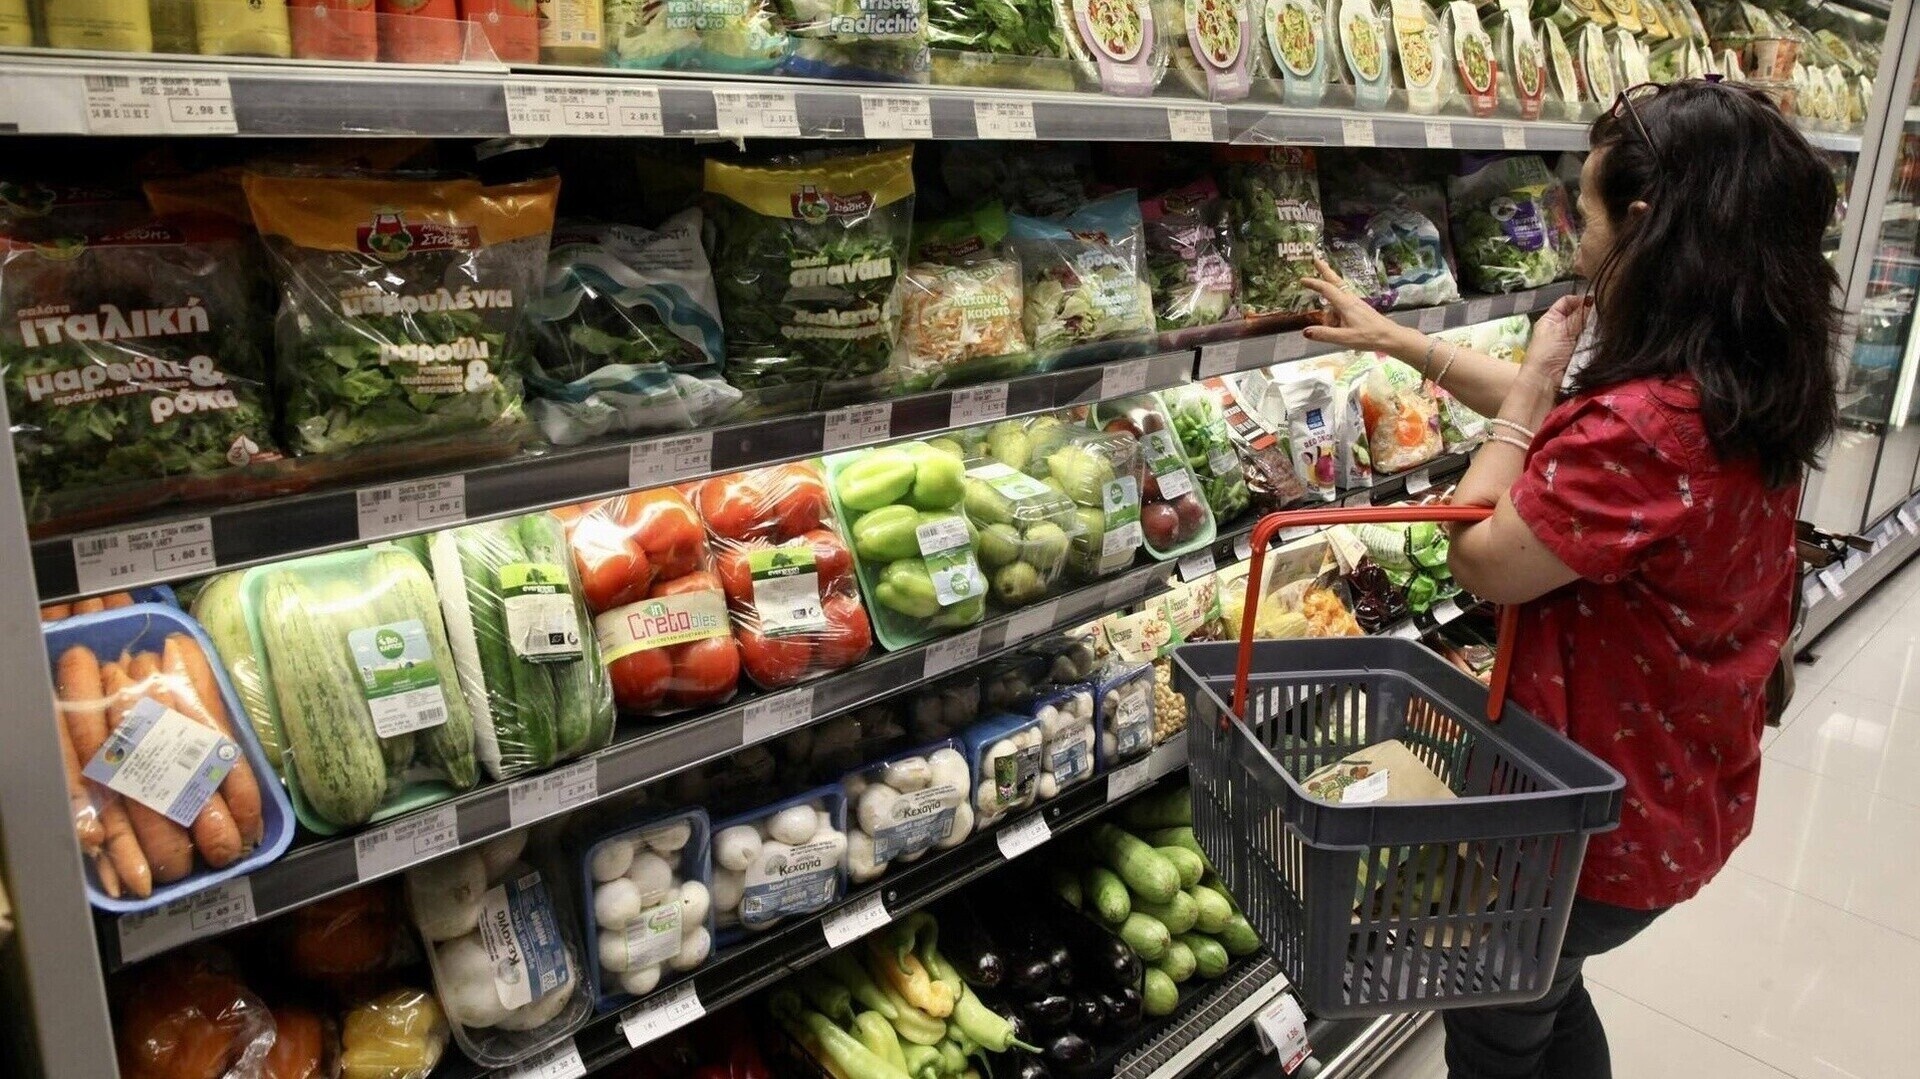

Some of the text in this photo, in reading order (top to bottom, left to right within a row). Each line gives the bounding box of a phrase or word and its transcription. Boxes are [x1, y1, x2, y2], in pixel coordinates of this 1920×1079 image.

[830, 14, 919, 34] radicchio
[340, 284, 513, 317] μαρουλένια
[20, 296, 210, 347] ιταλική
[379, 336, 490, 366] μαρούλι
[26, 355, 228, 402] μαρούλι &
[464, 359, 495, 393] &
[150, 389, 239, 424] ρόκα
[903, 800, 941, 818] Κεχαγιά
[779, 857, 821, 876] Κεχαγιά
[497, 910, 520, 966] Κεχαγιά
